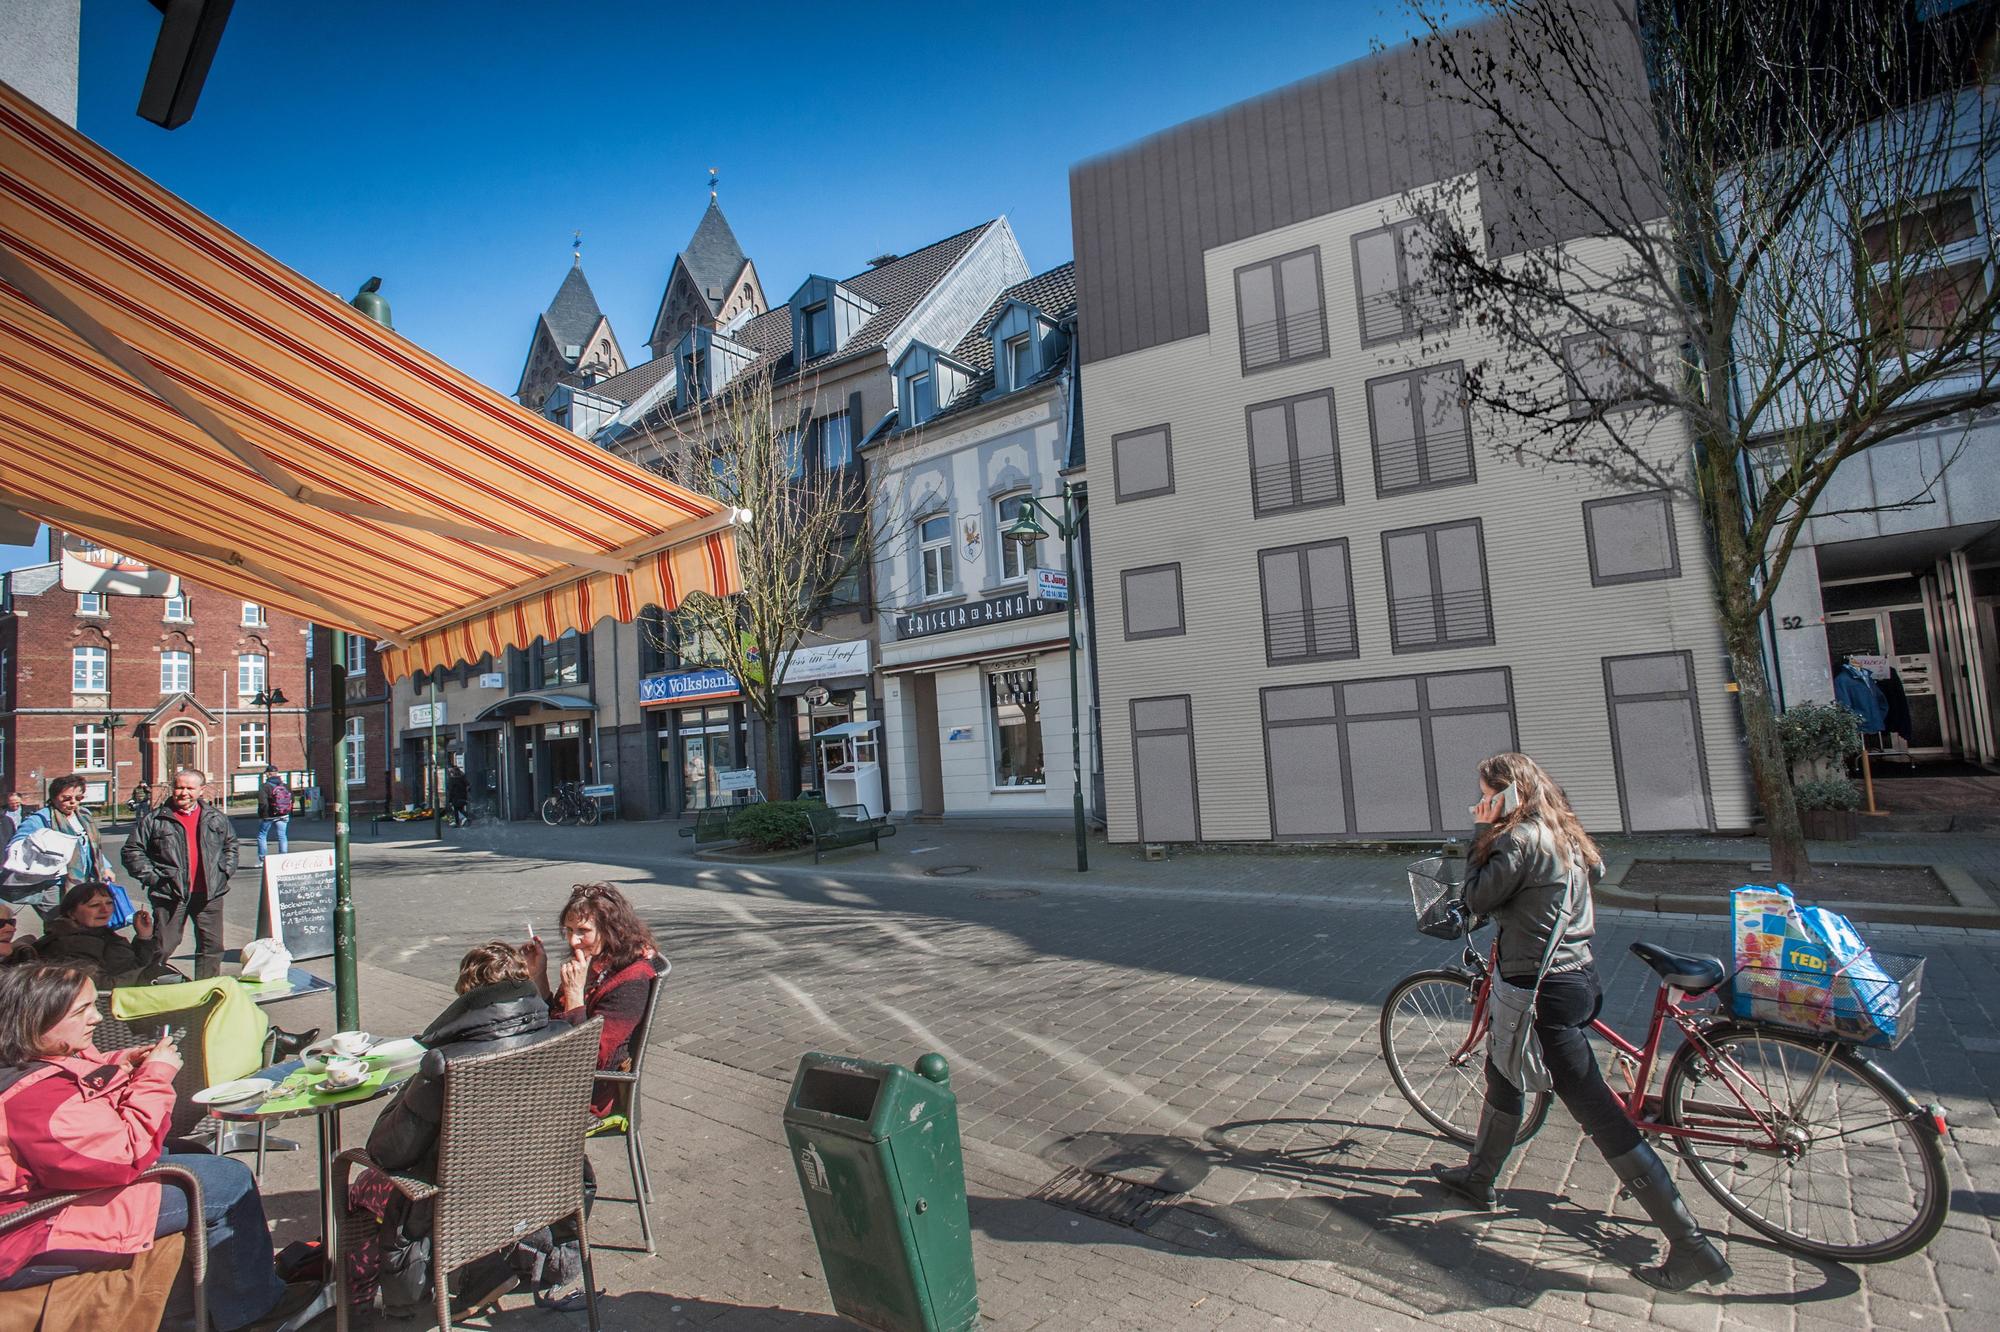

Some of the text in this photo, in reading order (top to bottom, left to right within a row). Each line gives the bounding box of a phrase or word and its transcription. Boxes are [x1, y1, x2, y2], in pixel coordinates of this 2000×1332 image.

[908, 607, 966, 634] FRISEUR
[1782, 616, 1802, 630] 52
[669, 672, 736, 693] Volksbank
